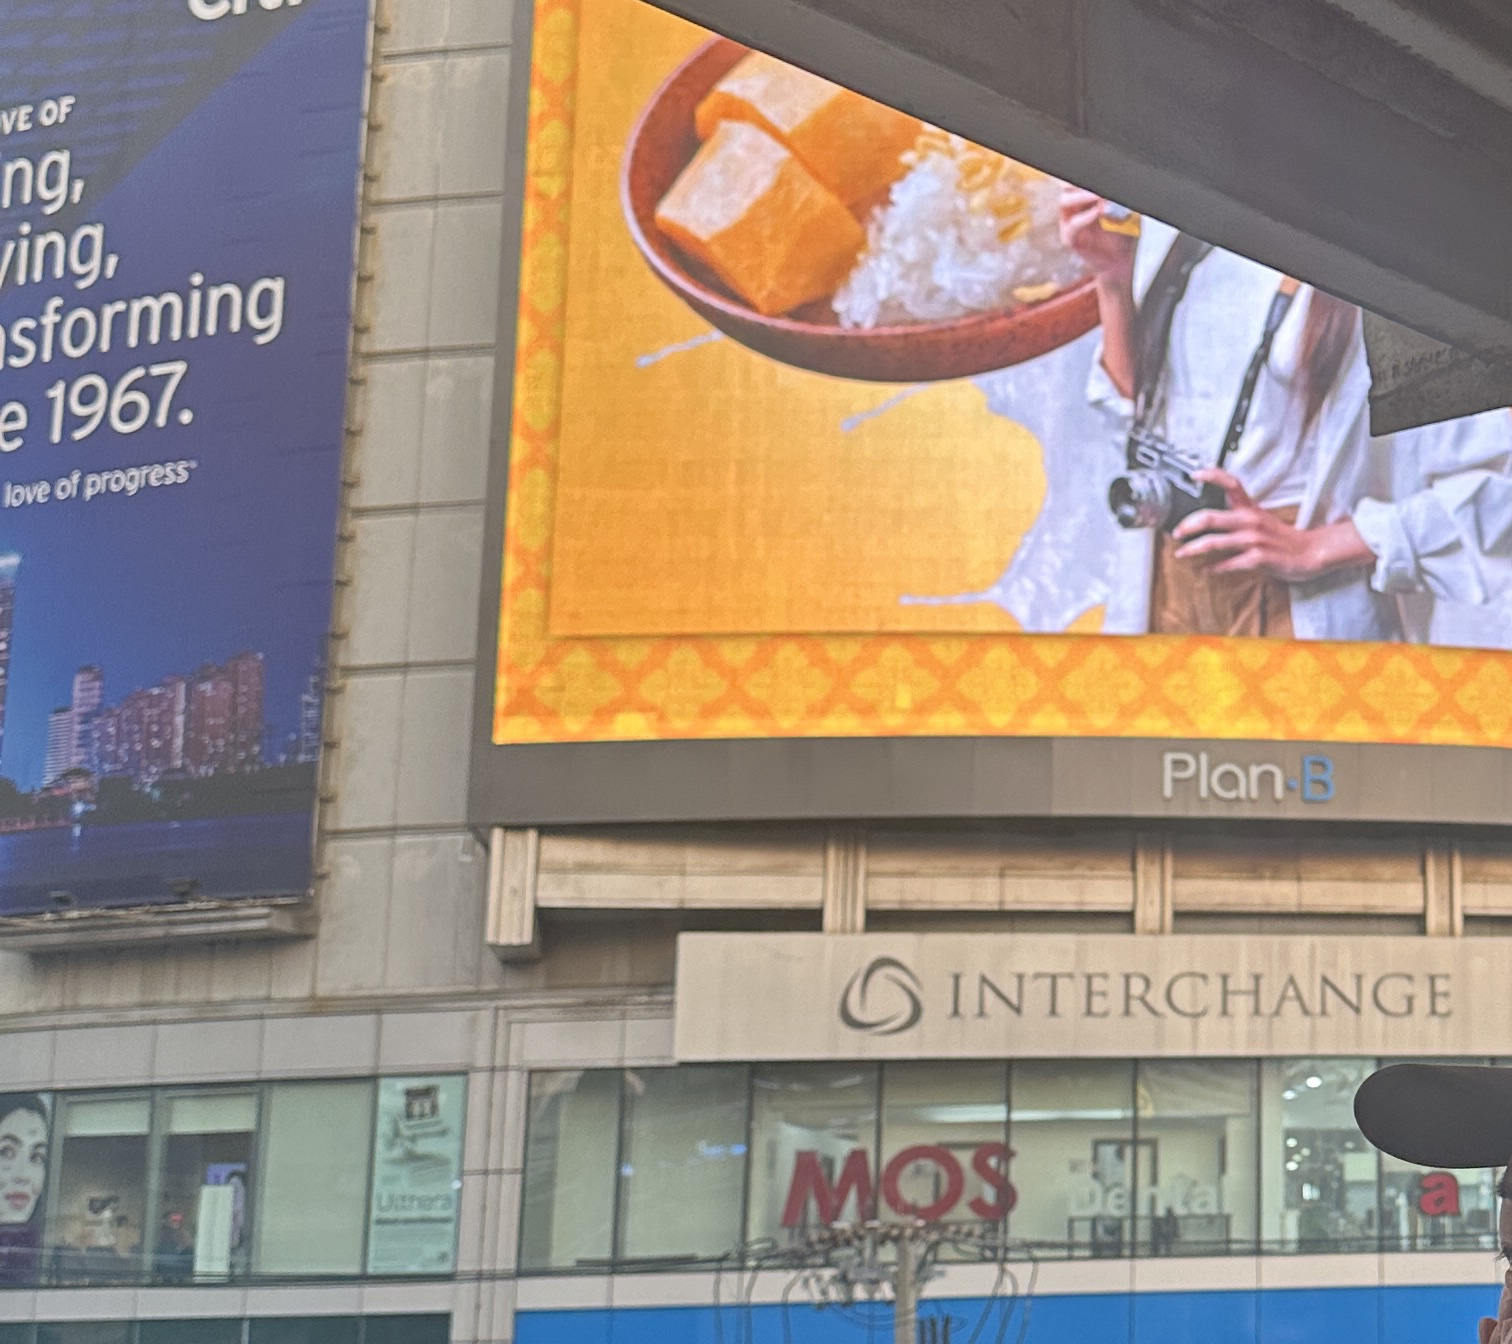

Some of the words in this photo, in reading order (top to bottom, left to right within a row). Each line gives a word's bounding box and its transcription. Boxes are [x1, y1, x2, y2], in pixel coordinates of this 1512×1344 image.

[40, 95, 76, 127] OF
[46, 360, 194, 444] 1967.
[4, 480, 51, 508] love
[55, 469, 82, 500] of
[948, 971, 1453, 1020] INTERCHANGE
[781, 1142, 1017, 1228] MOS
